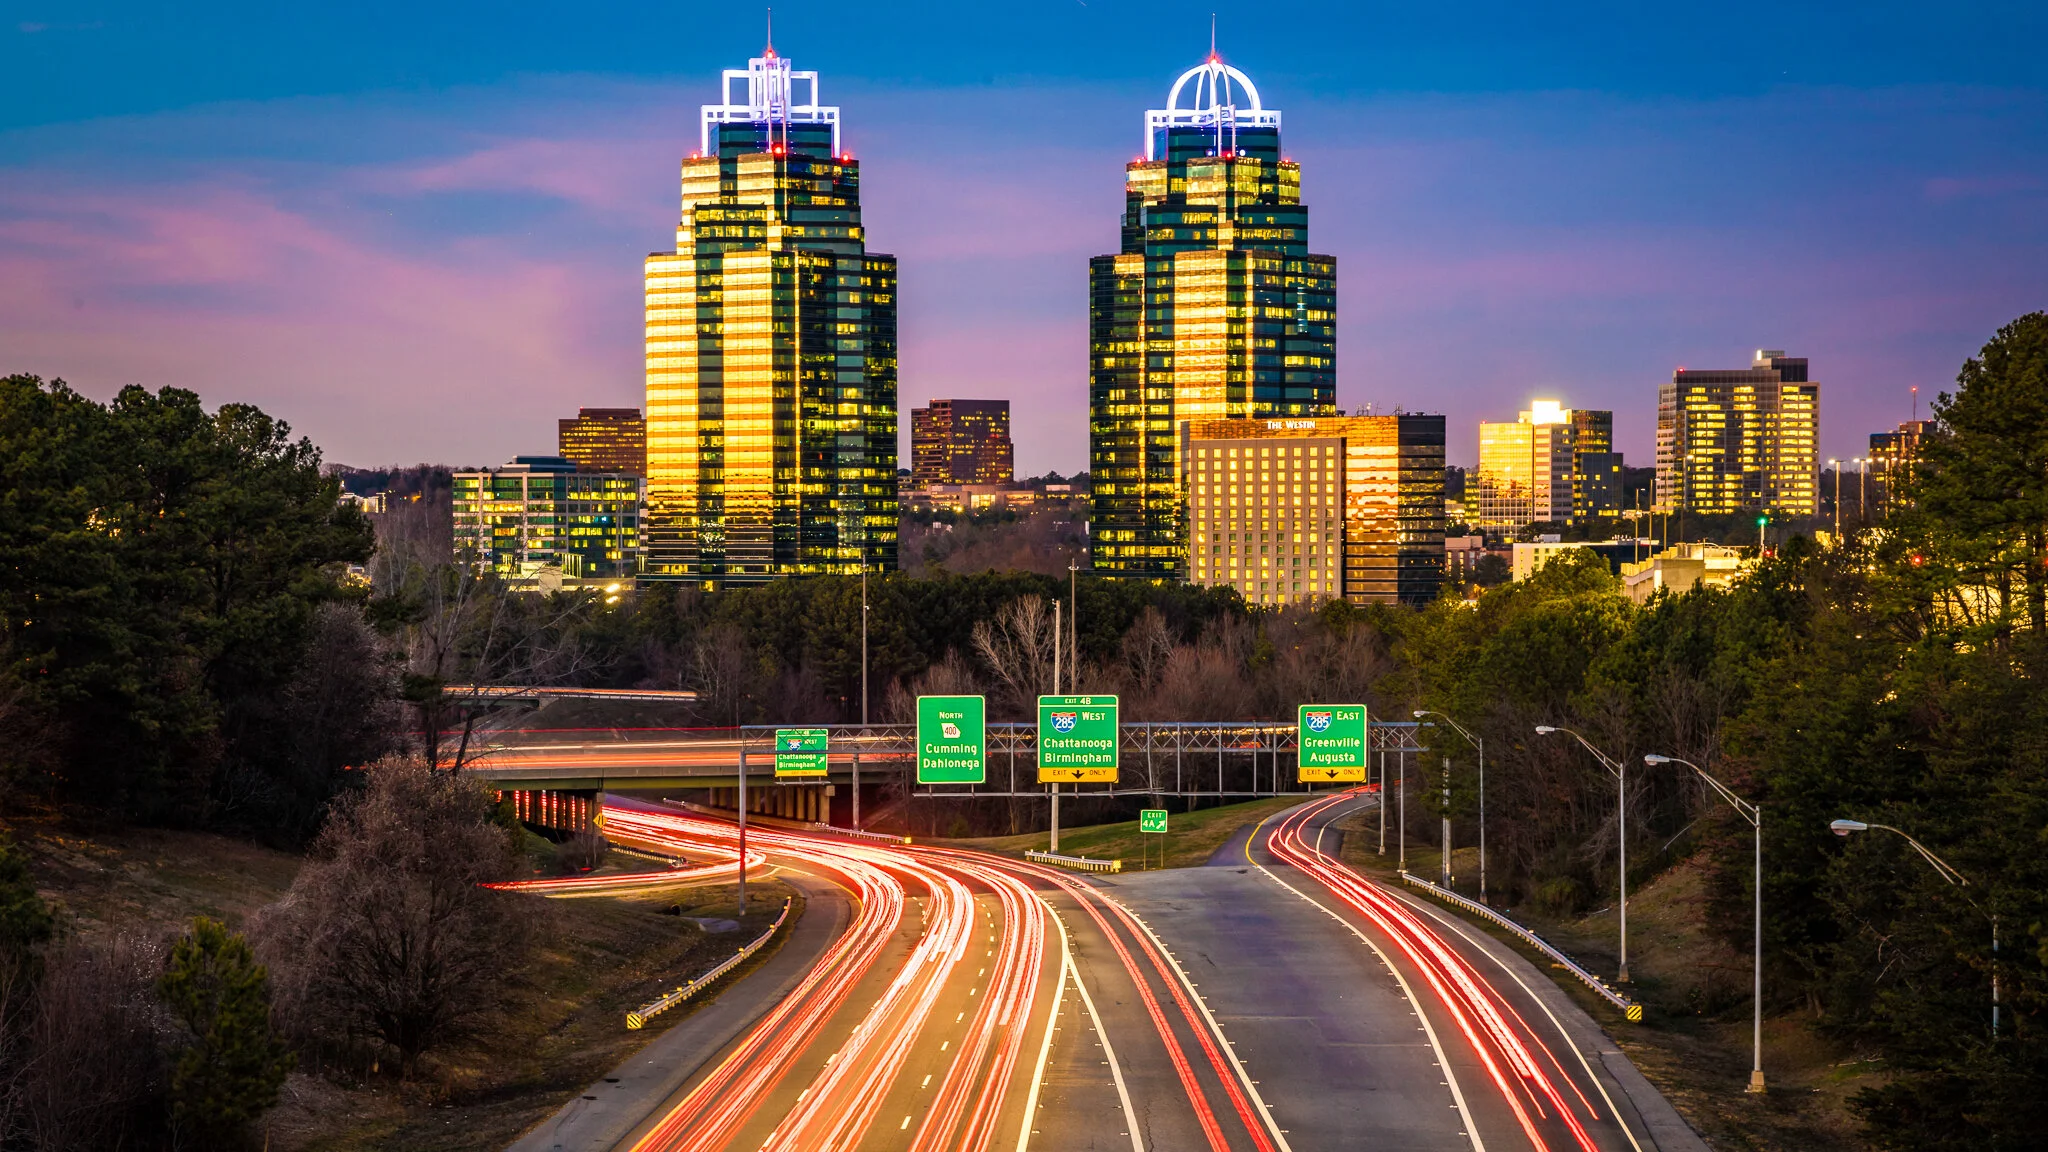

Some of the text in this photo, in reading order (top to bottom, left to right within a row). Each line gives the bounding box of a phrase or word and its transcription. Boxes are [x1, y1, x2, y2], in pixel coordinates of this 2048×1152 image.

[1267, 420, 1316, 429] THE WESTIN
[939, 711, 963, 719] NORTH
[1082, 712, 1105, 720] WEST
[1337, 711, 1359, 720] EAST
[1055, 717, 1075, 729] 285
[1310, 717, 1329, 728] 285
[944, 726, 957, 735] 400
[1043, 738, 1113, 750] Chattanooga
[1305, 738, 1360, 747] Greenville
[925, 743, 977, 756] Cumming
[778, 753, 817, 761] Chattanooga
[1044, 753, 1112, 765] Birmingham
[1309, 752, 1356, 764] Augusta
[923, 758, 980, 770] Dahlonega
